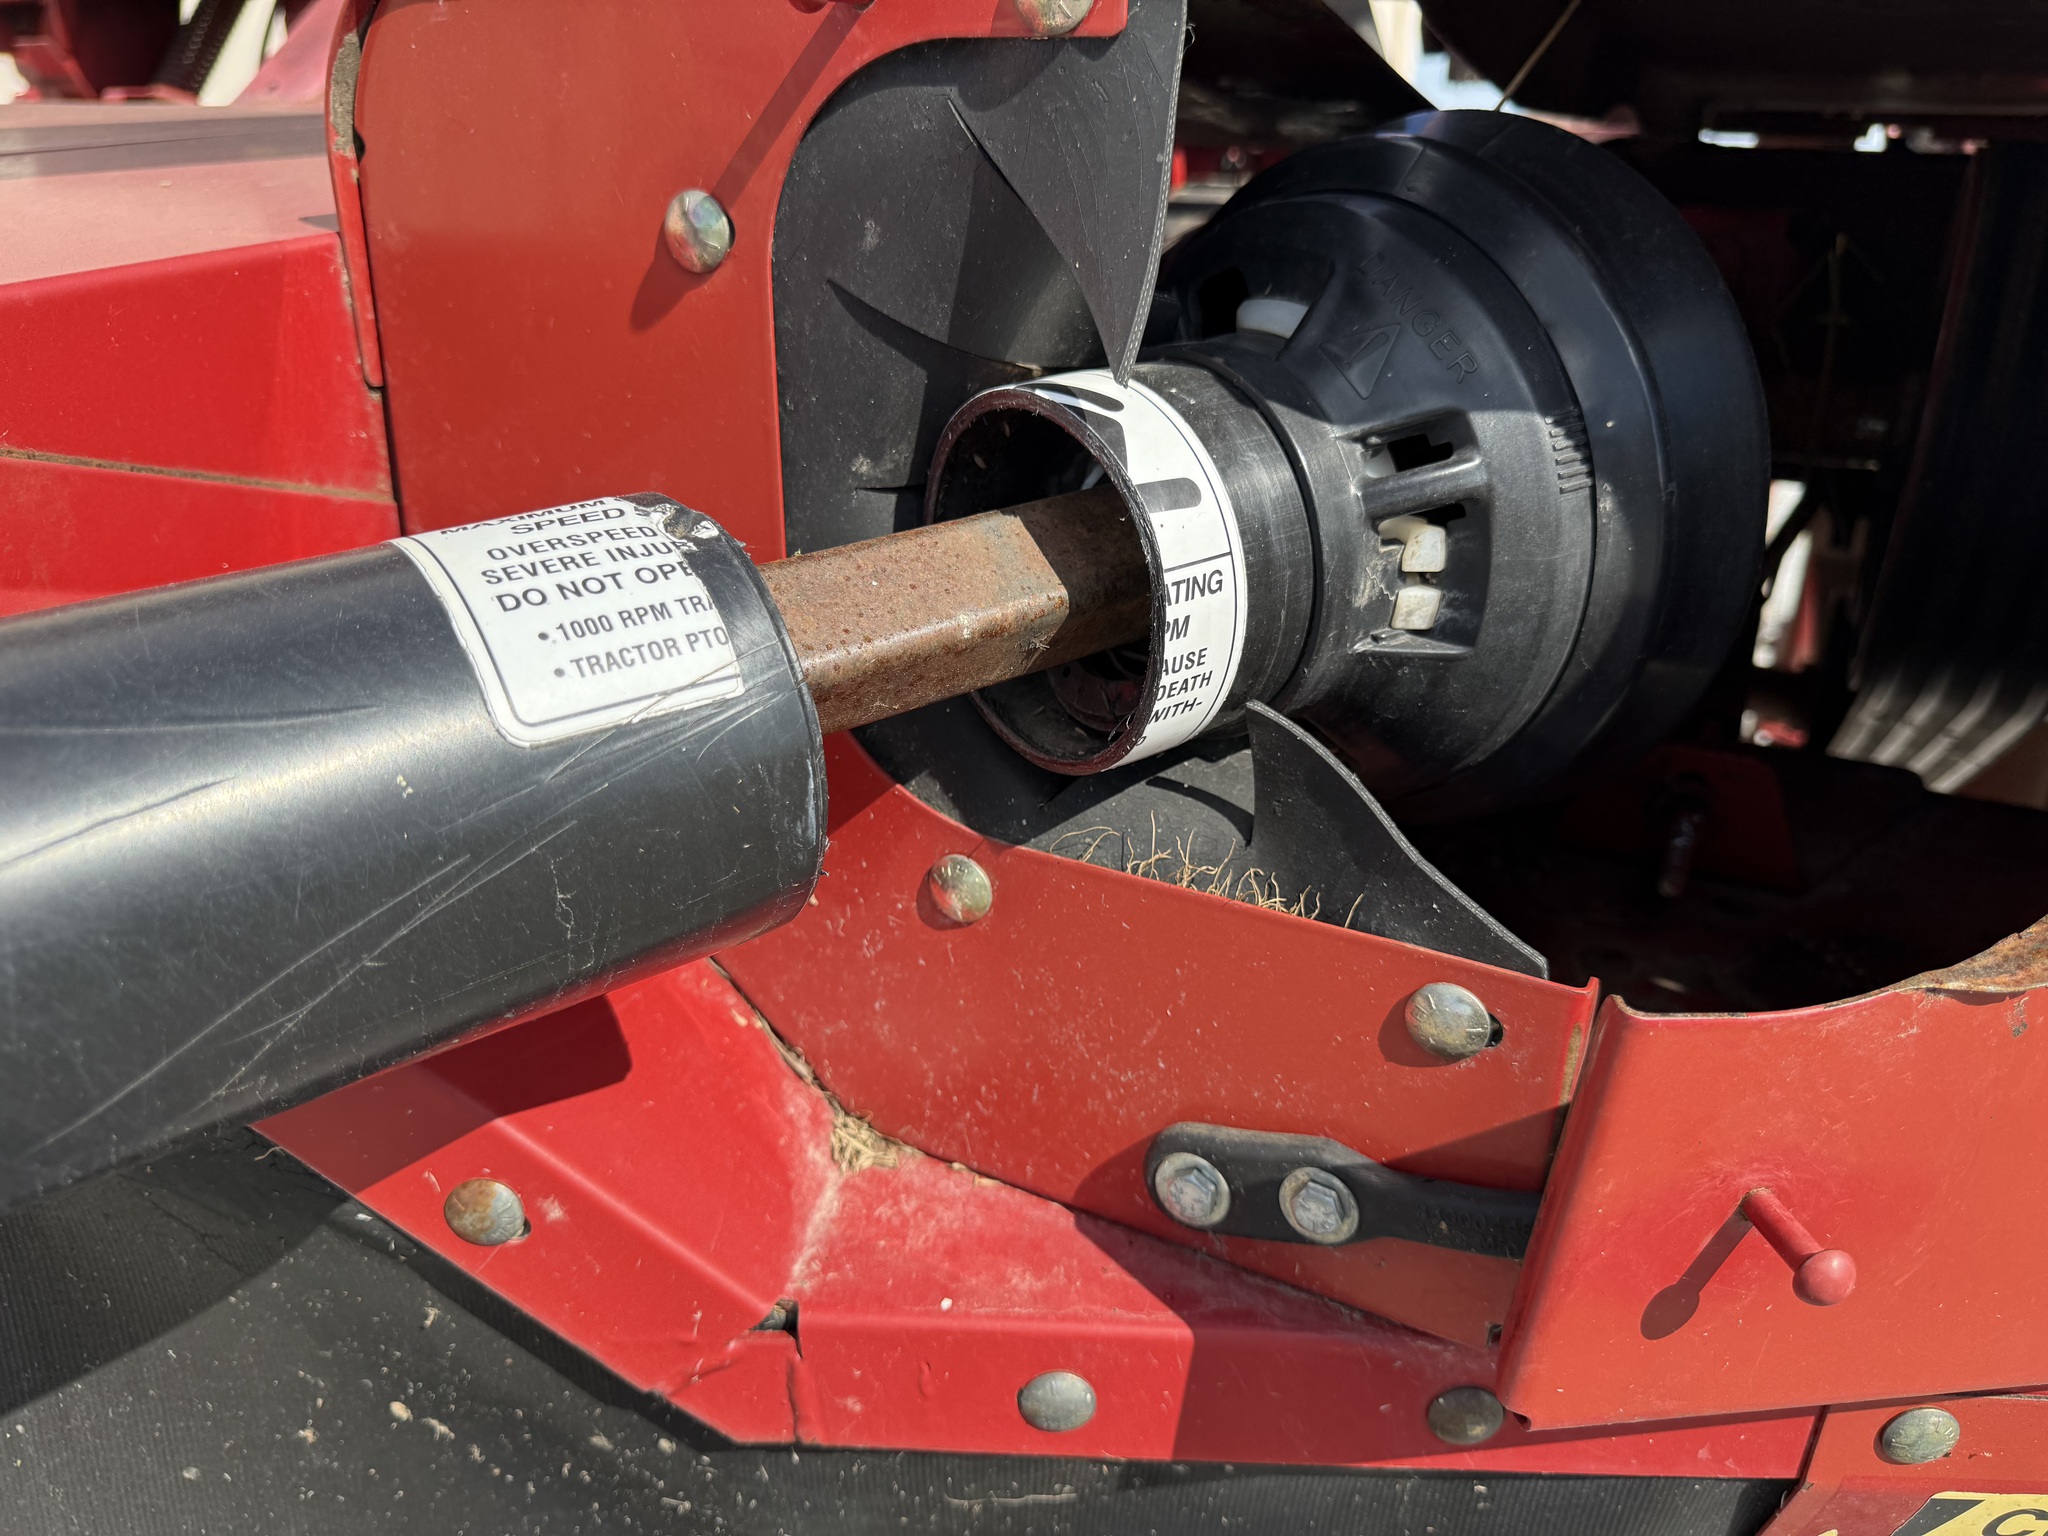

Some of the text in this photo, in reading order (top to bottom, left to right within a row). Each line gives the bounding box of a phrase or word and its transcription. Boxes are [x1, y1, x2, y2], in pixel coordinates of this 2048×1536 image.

[1358, 252, 1478, 384] DANGER
[440, 499, 606, 535] MAXIMUM
[510, 507, 626, 535] SPEED
[486, 526, 659, 561] OVERSPEED
[480, 552, 602, 585] SEVERE
[495, 588, 548, 613] DO
[555, 572, 624, 601] NOT
[555, 614, 614, 642] 1000
[617, 601, 674, 629] RPM
[569, 626, 730, 679] TRACTOR PTO
